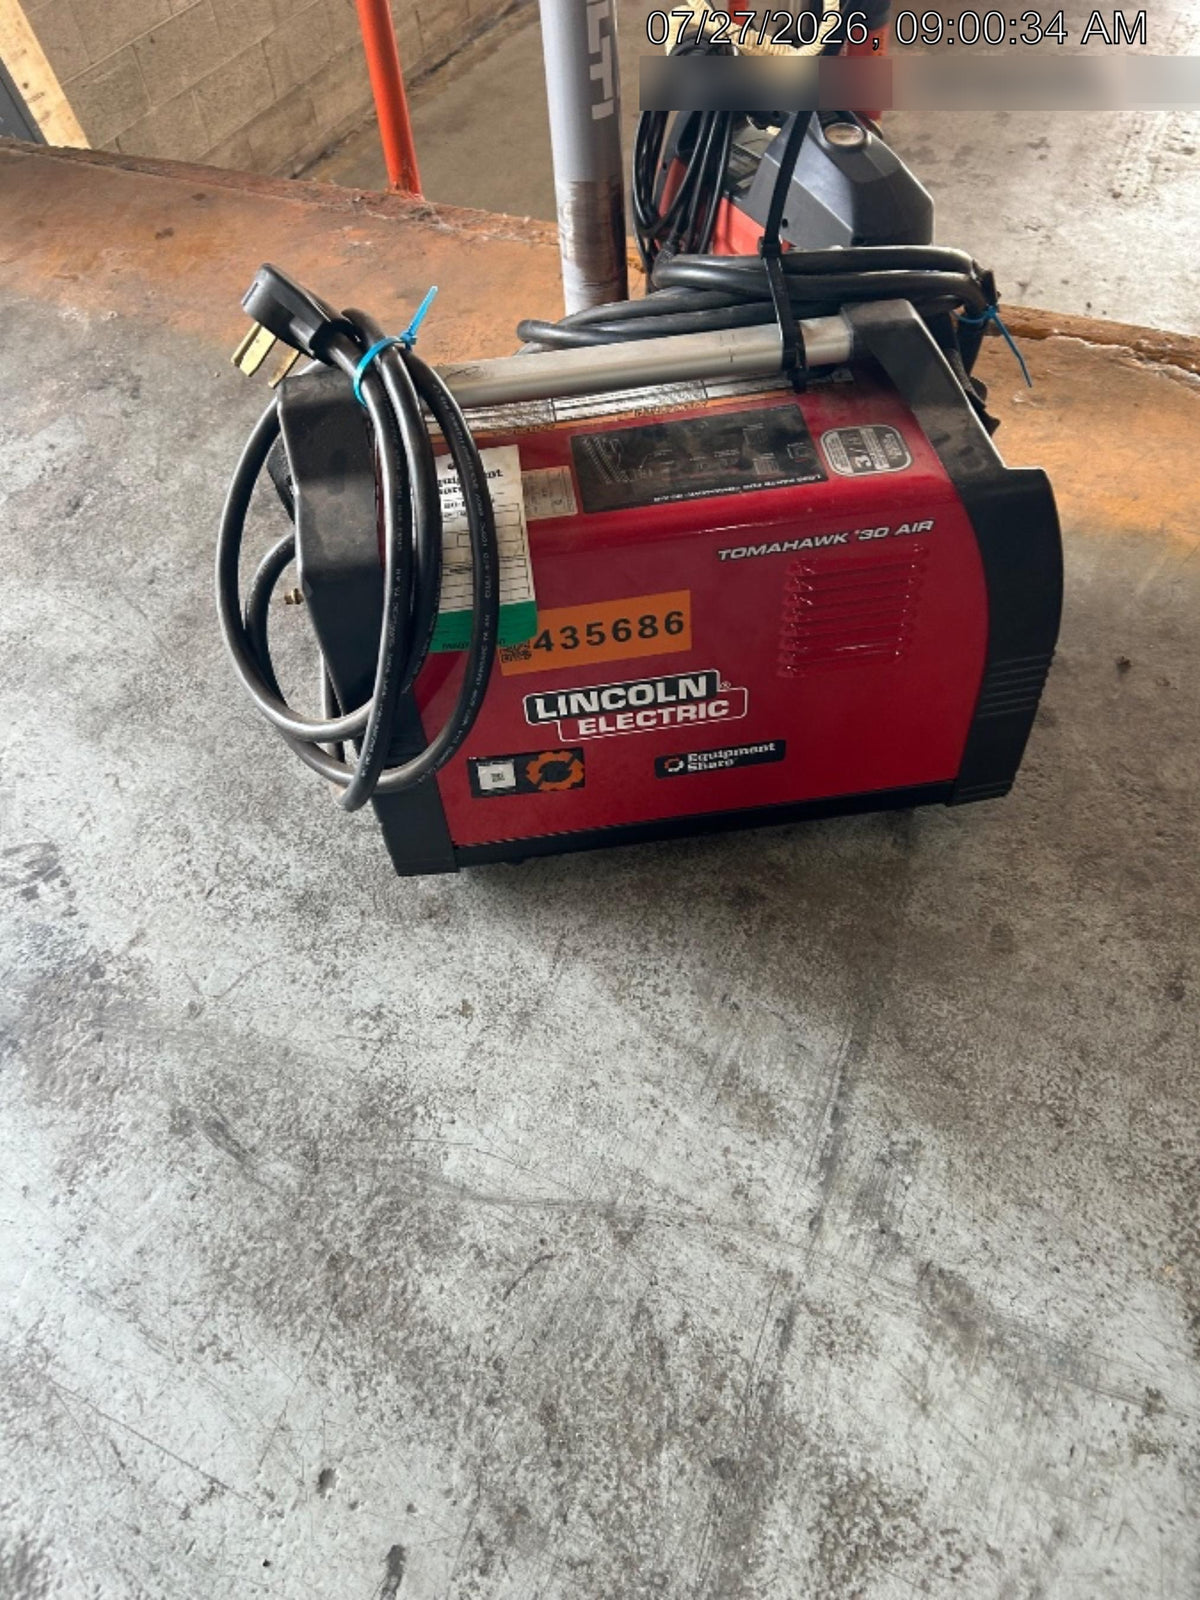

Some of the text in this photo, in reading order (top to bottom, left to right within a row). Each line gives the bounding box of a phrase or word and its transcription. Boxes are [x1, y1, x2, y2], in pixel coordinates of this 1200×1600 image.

[586, 0, 614, 120] LTI
[718, 532, 849, 562] TOMAHAWK
[895, 519, 934, 536] AIR
[532, 610, 685, 652] 435686
[535, 674, 708, 720] LINCOLN
[578, 698, 730, 736] ELECTRIC
[687, 742, 776, 763] Equipment
[687, 758, 735, 772] Share
